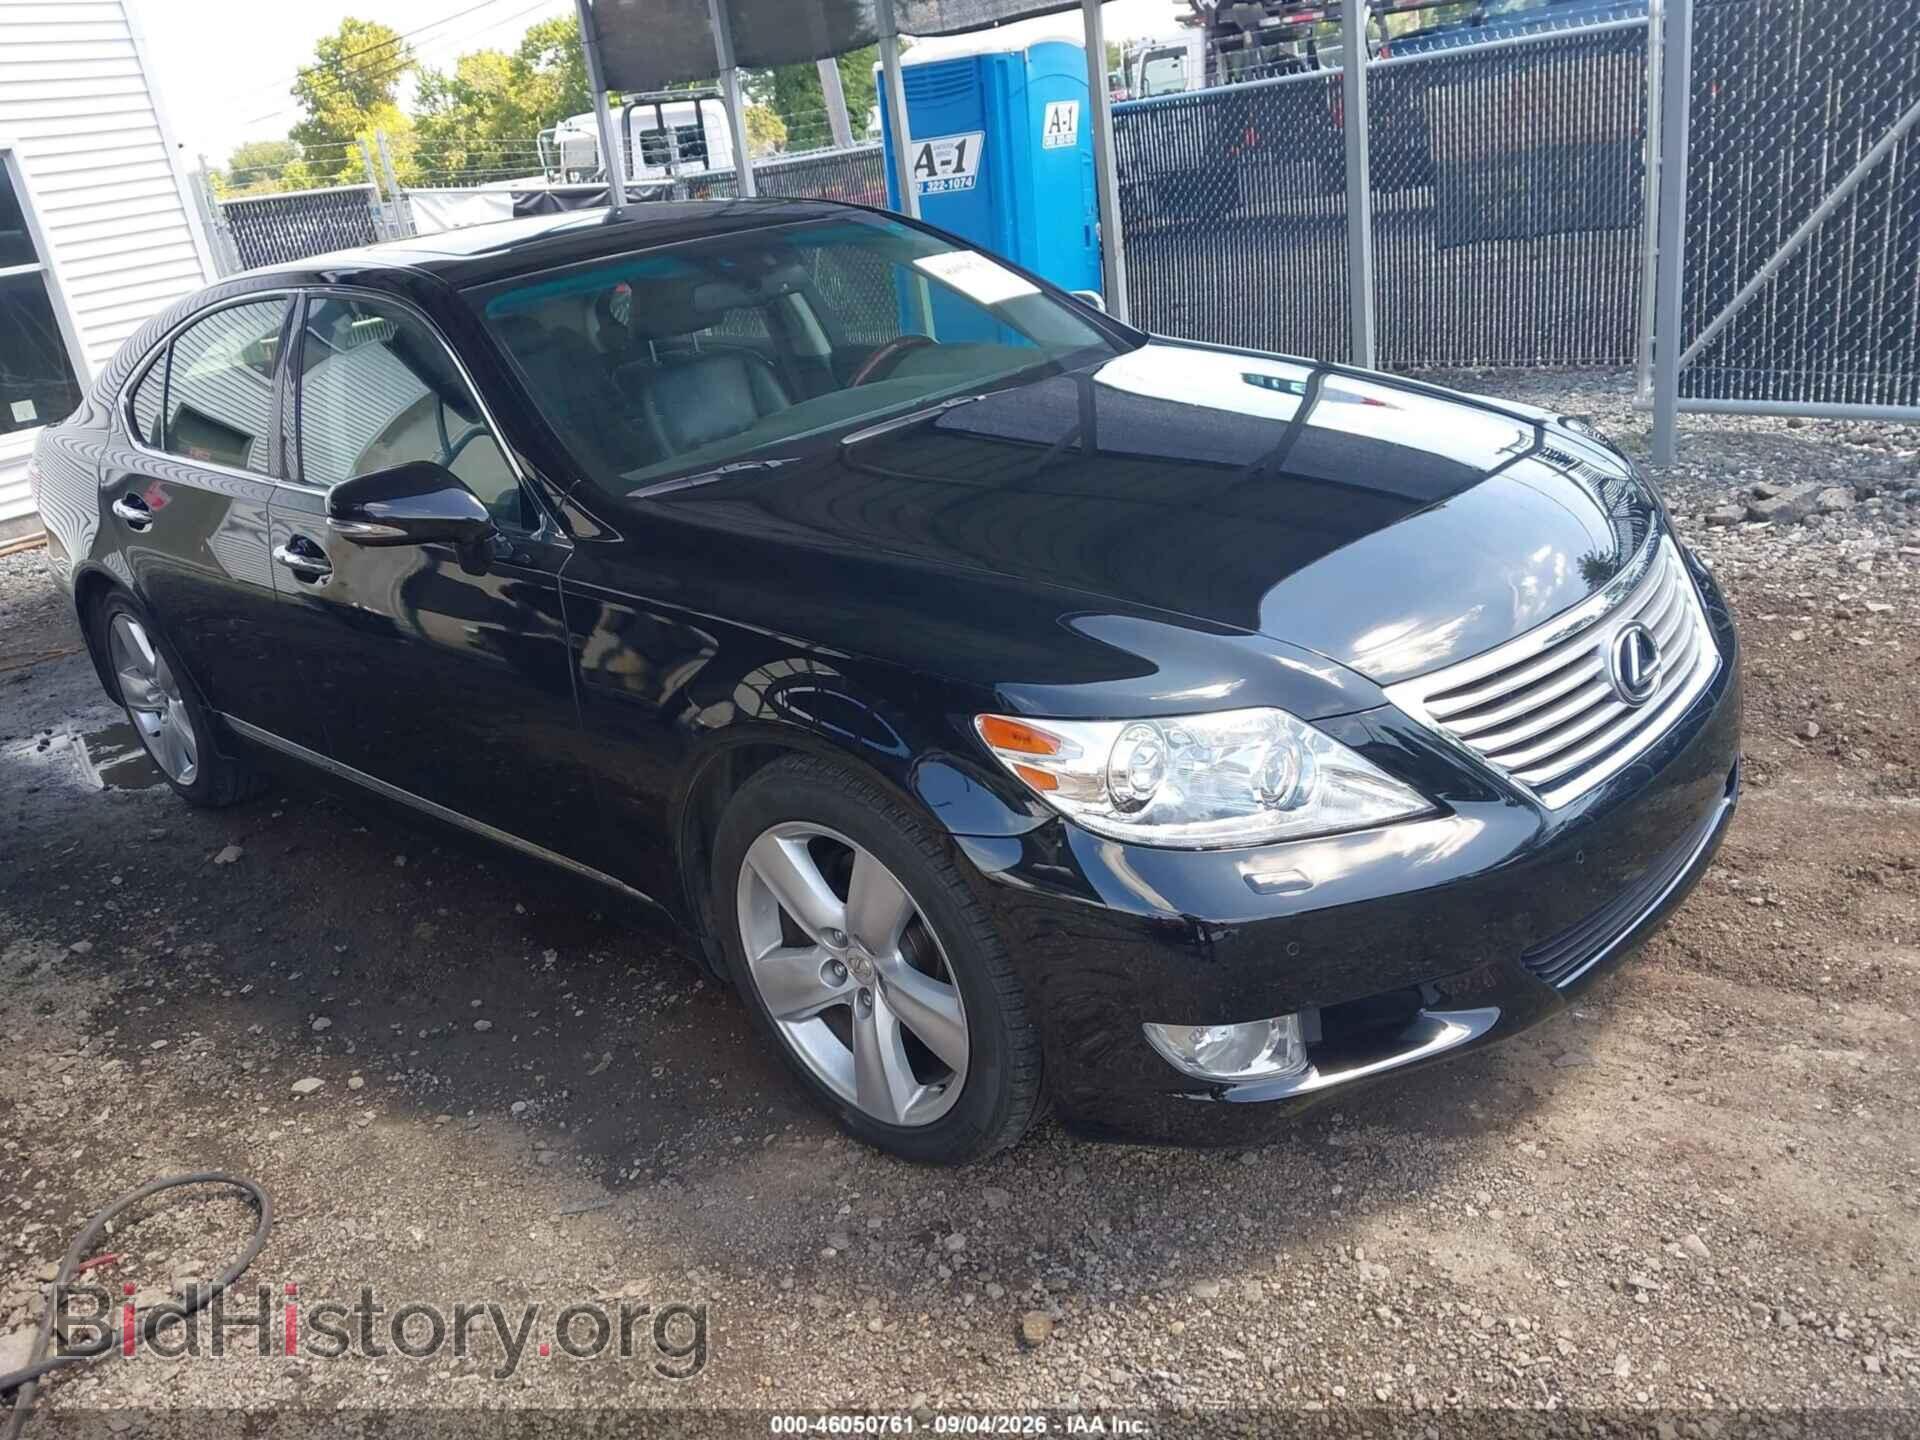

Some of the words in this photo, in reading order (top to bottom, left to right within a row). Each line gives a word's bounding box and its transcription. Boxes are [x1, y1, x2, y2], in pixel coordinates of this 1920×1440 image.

[1048, 105, 1073, 134] A-1
[914, 138, 967, 179] A-1
[927, 177, 973, 193] 322-1074
